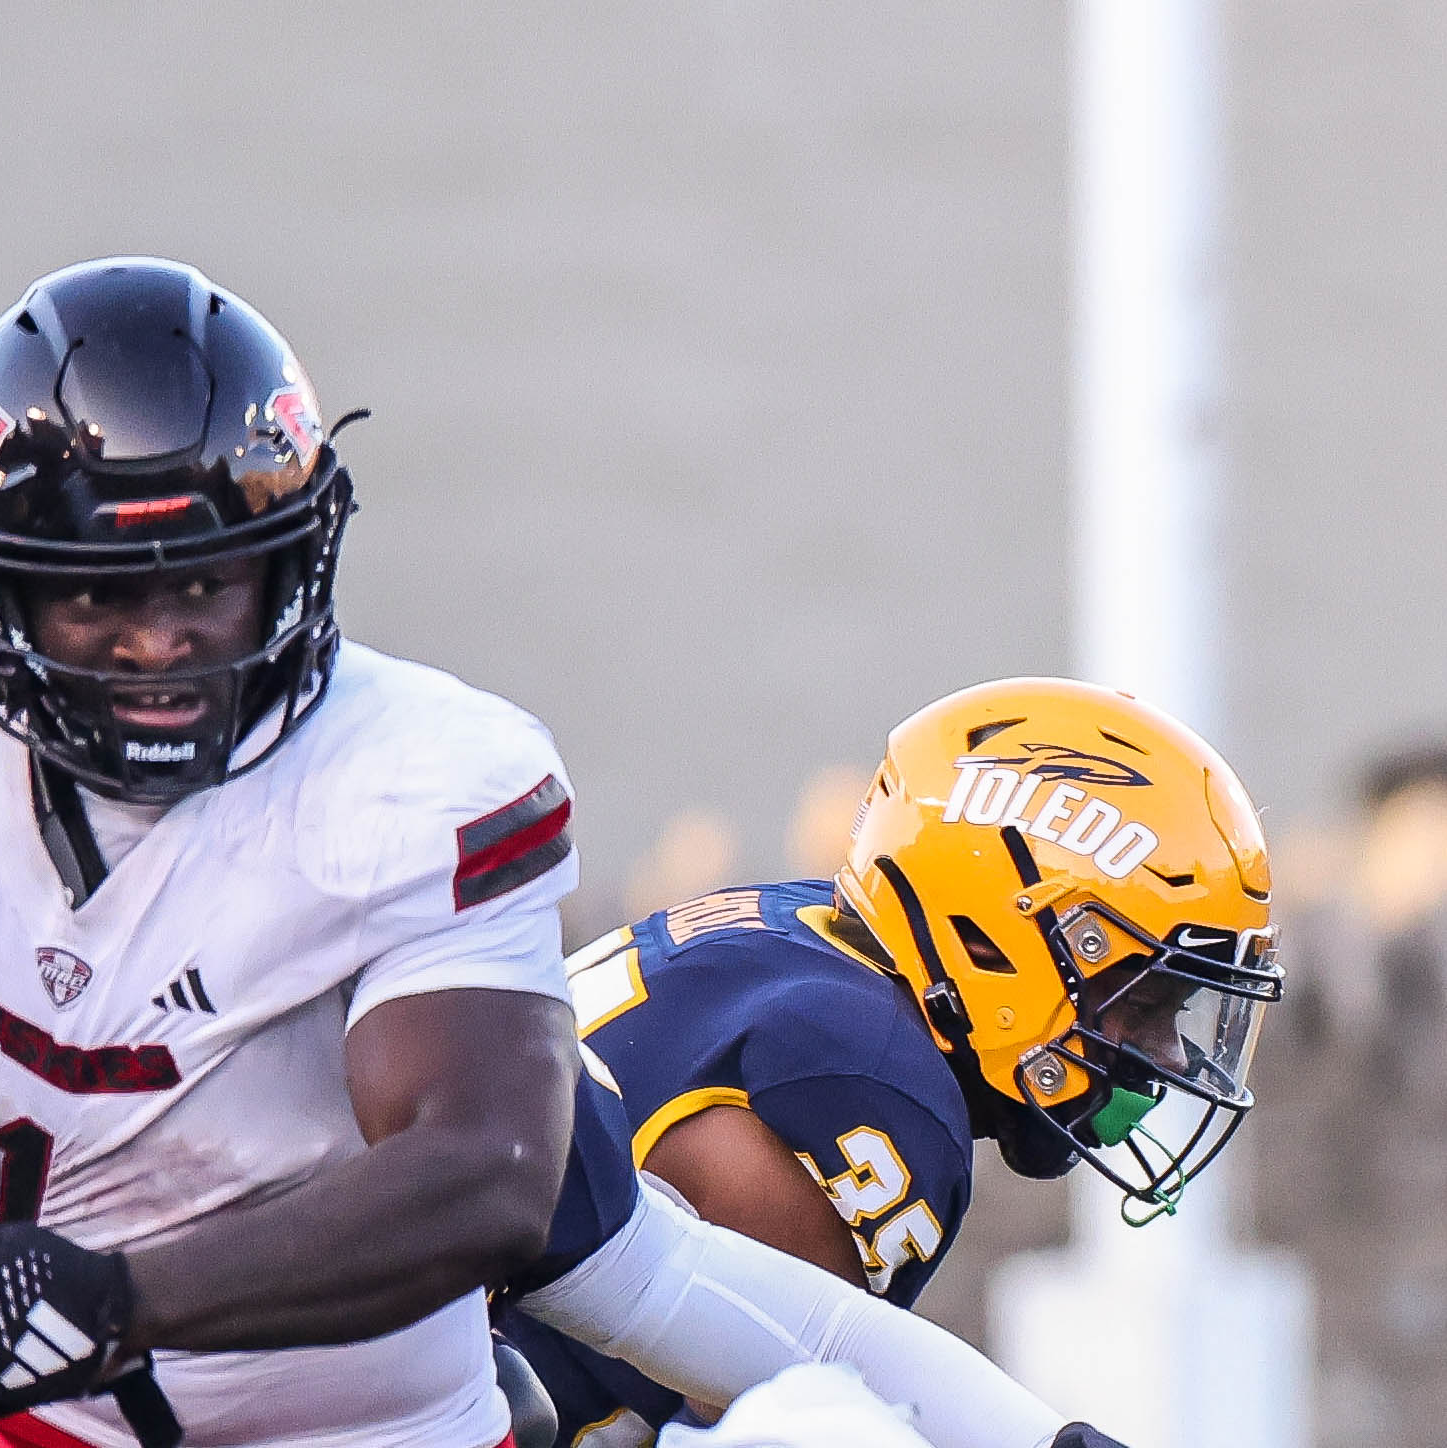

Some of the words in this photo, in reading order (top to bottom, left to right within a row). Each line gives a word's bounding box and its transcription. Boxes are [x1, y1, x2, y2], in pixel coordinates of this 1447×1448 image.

[125, 741, 196, 762] Riddell
[941, 756, 1160, 880] TOLEDO
[793, 1125, 944, 1294] 35
